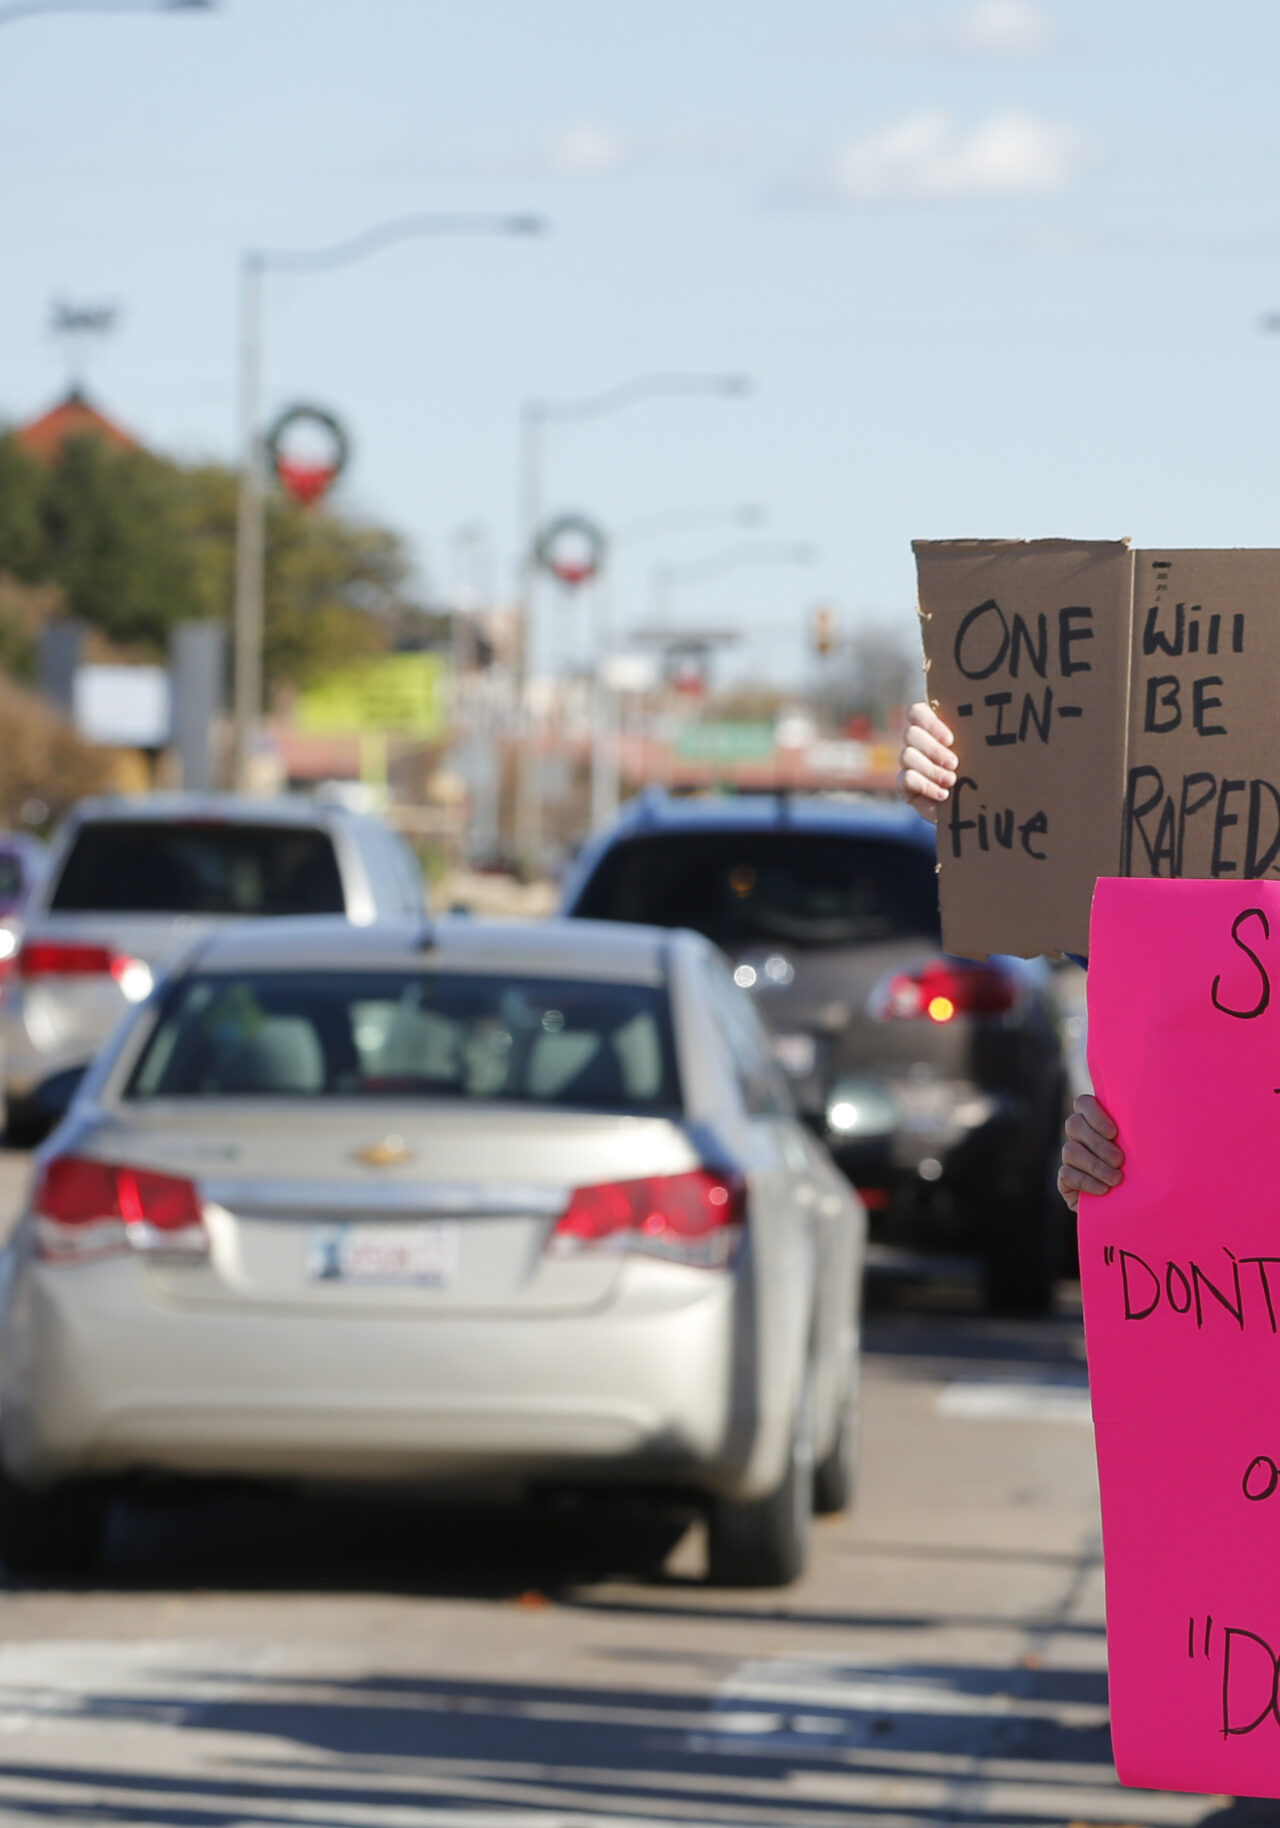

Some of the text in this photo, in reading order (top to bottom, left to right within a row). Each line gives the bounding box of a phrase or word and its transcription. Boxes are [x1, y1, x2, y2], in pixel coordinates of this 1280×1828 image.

[954, 599, 1095, 680] ONE
[1143, 602, 1244, 656] Will
[1144, 675, 1227, 736] BE
[948, 775, 1048, 859] five
